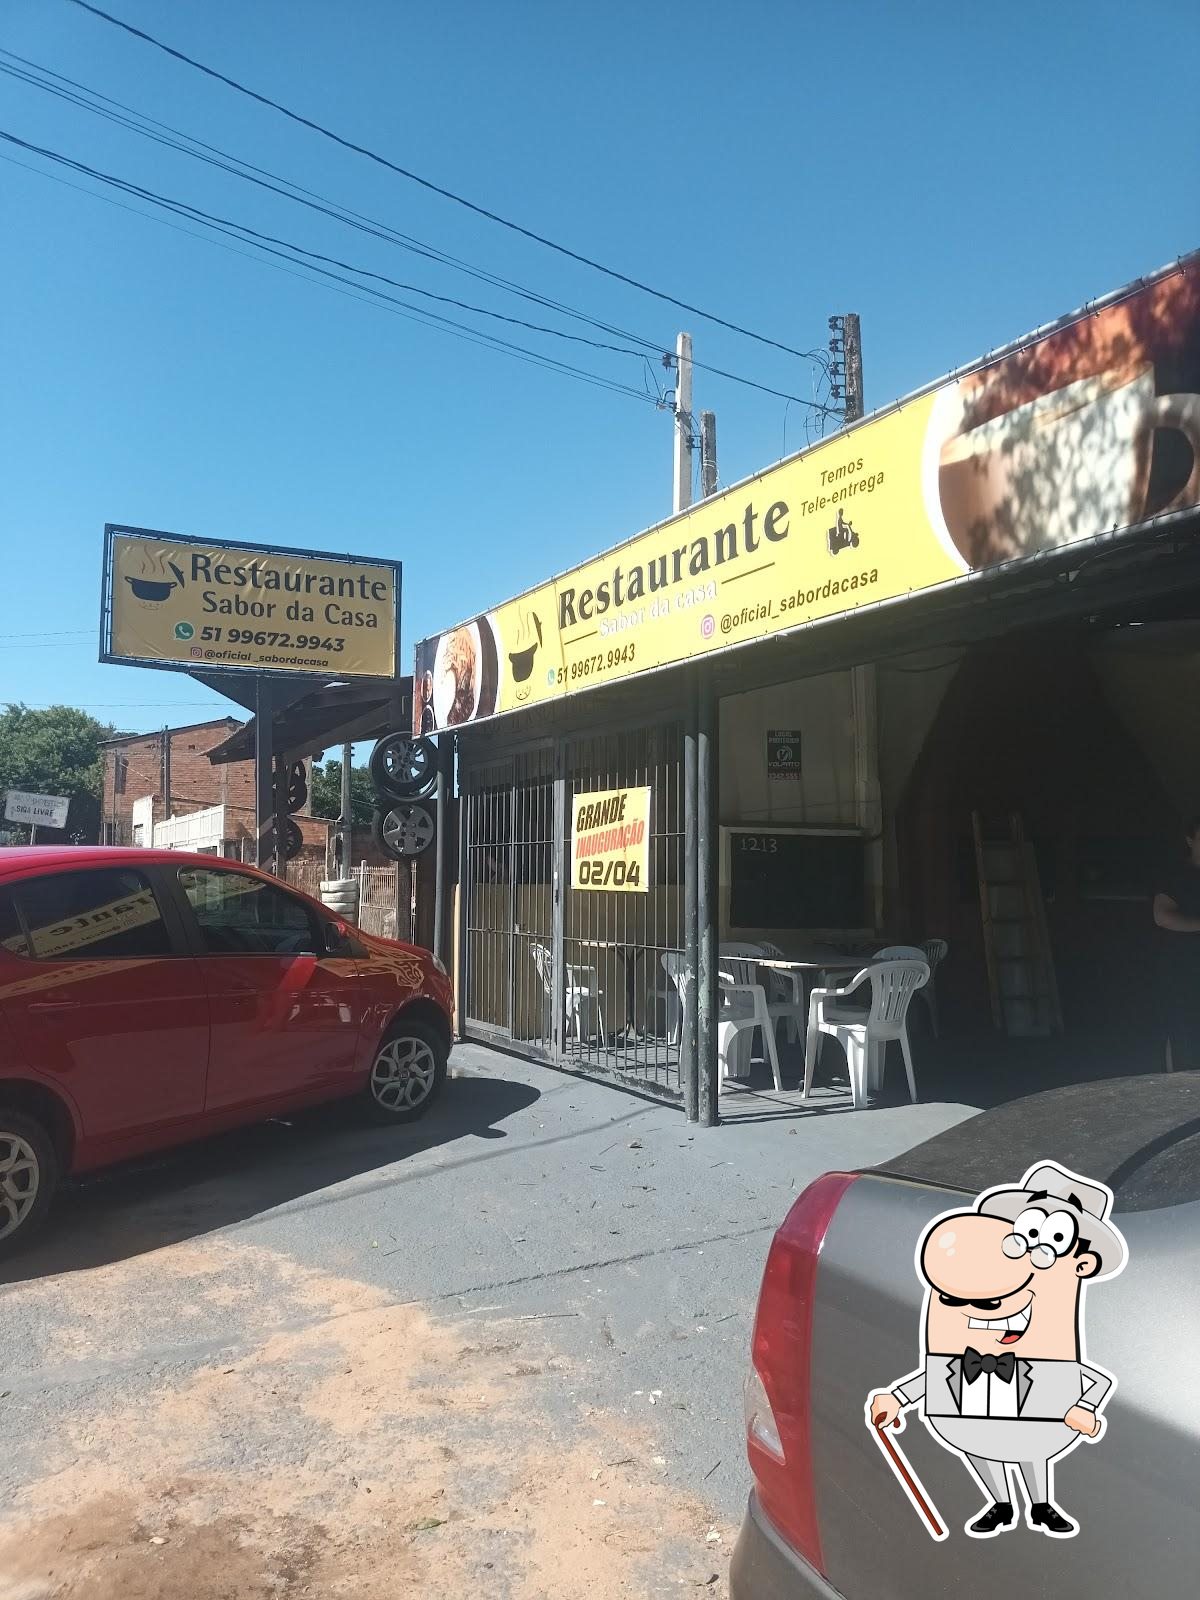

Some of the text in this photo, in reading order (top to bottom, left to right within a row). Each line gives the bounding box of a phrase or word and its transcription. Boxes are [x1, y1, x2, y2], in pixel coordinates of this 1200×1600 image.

[820, 457, 863, 487] Temos
[801, 471, 884, 517] Tele-entrega
[191, 553, 387, 601] Restaurante
[559, 500, 789, 630] Restaurante
[202, 590, 378, 628] Sabor da Casa
[600, 579, 717, 637] Sabor da casa
[720, 568, 878, 633] @oficial_sabordacasa
[200, 626, 345, 651] 51 99672.9943
[557, 643, 635, 684] 51 99672.9943
[576, 793, 627, 832] GRANDE
[576, 818, 644, 859] INAUGURAÇÃO
[579, 860, 640, 887] 02/04
